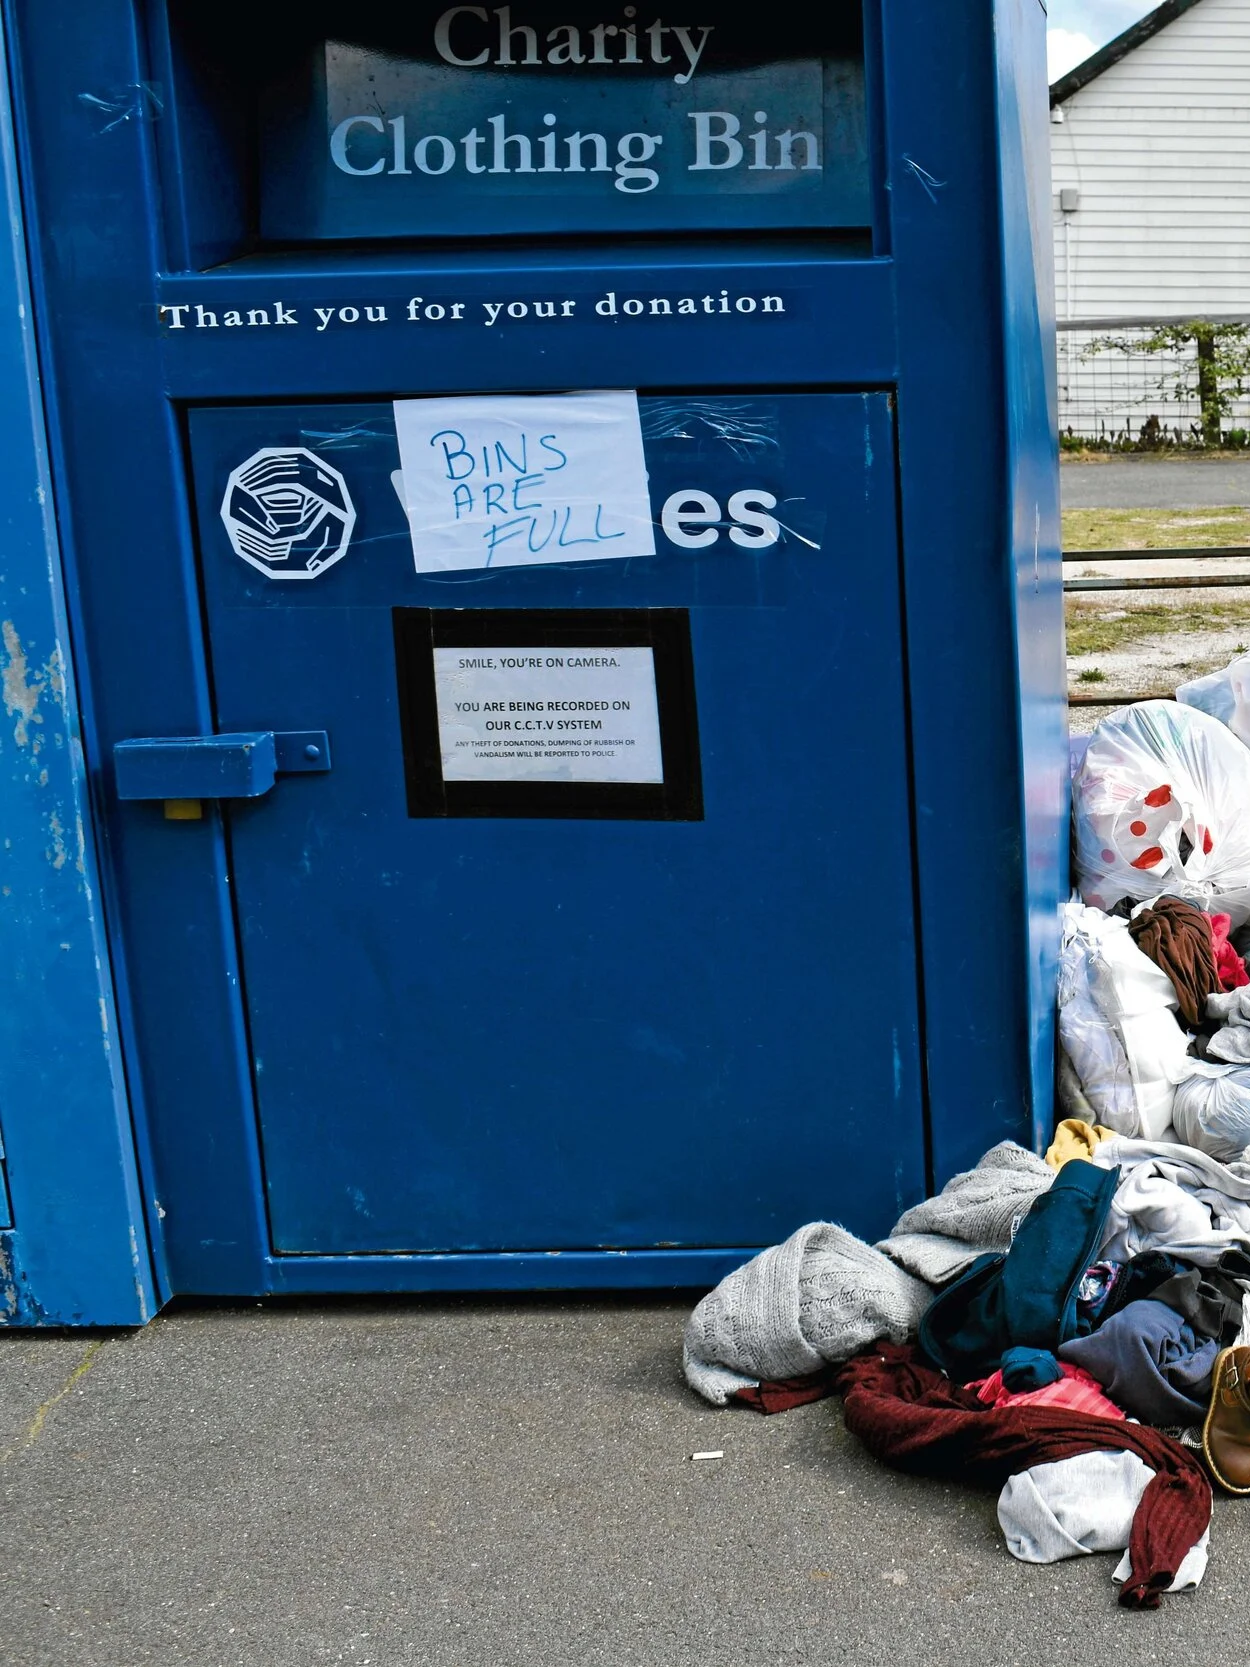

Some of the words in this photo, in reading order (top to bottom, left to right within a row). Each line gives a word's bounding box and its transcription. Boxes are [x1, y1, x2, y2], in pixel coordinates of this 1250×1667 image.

[434, 4, 715, 83] Charity
[330, 112, 663, 193] Clothing
[687, 110, 823, 172] Bin
[161, 303, 298, 330] Thank
[315, 302, 388, 331] you
[407, 296, 466, 323] for
[483, 298, 577, 326] your
[595, 289, 786, 318] donation
[430, 430, 567, 480] BINS
[452, 473, 546, 519] ARE
[483, 504, 626, 567] FULL
[458, 658, 497, 670] SMILE,
[500, 657, 543, 668] YOU'RE
[546, 657, 564, 668] ON
[567, 657, 621, 668] CAMERA.
[455, 702, 480, 712] YOU
[483, 702, 506, 712] ARE
[509, 701, 544, 712] BEING
[547, 700, 609, 711] RECORDED
[612, 700, 631, 711] ON
[485, 720, 511, 731] OUR
[514, 720, 554, 731] C.C.T.V
[557, 719, 602, 730] SYSTEM
[471, 740, 491, 748] THEFT
[503, 740, 547, 748] DONATIONS,
[548, 739, 582, 747] DUMPING
[583, 739, 593, 747] OF
[594, 739, 624, 747] RUBBISH
[625, 739, 636, 747] OR
